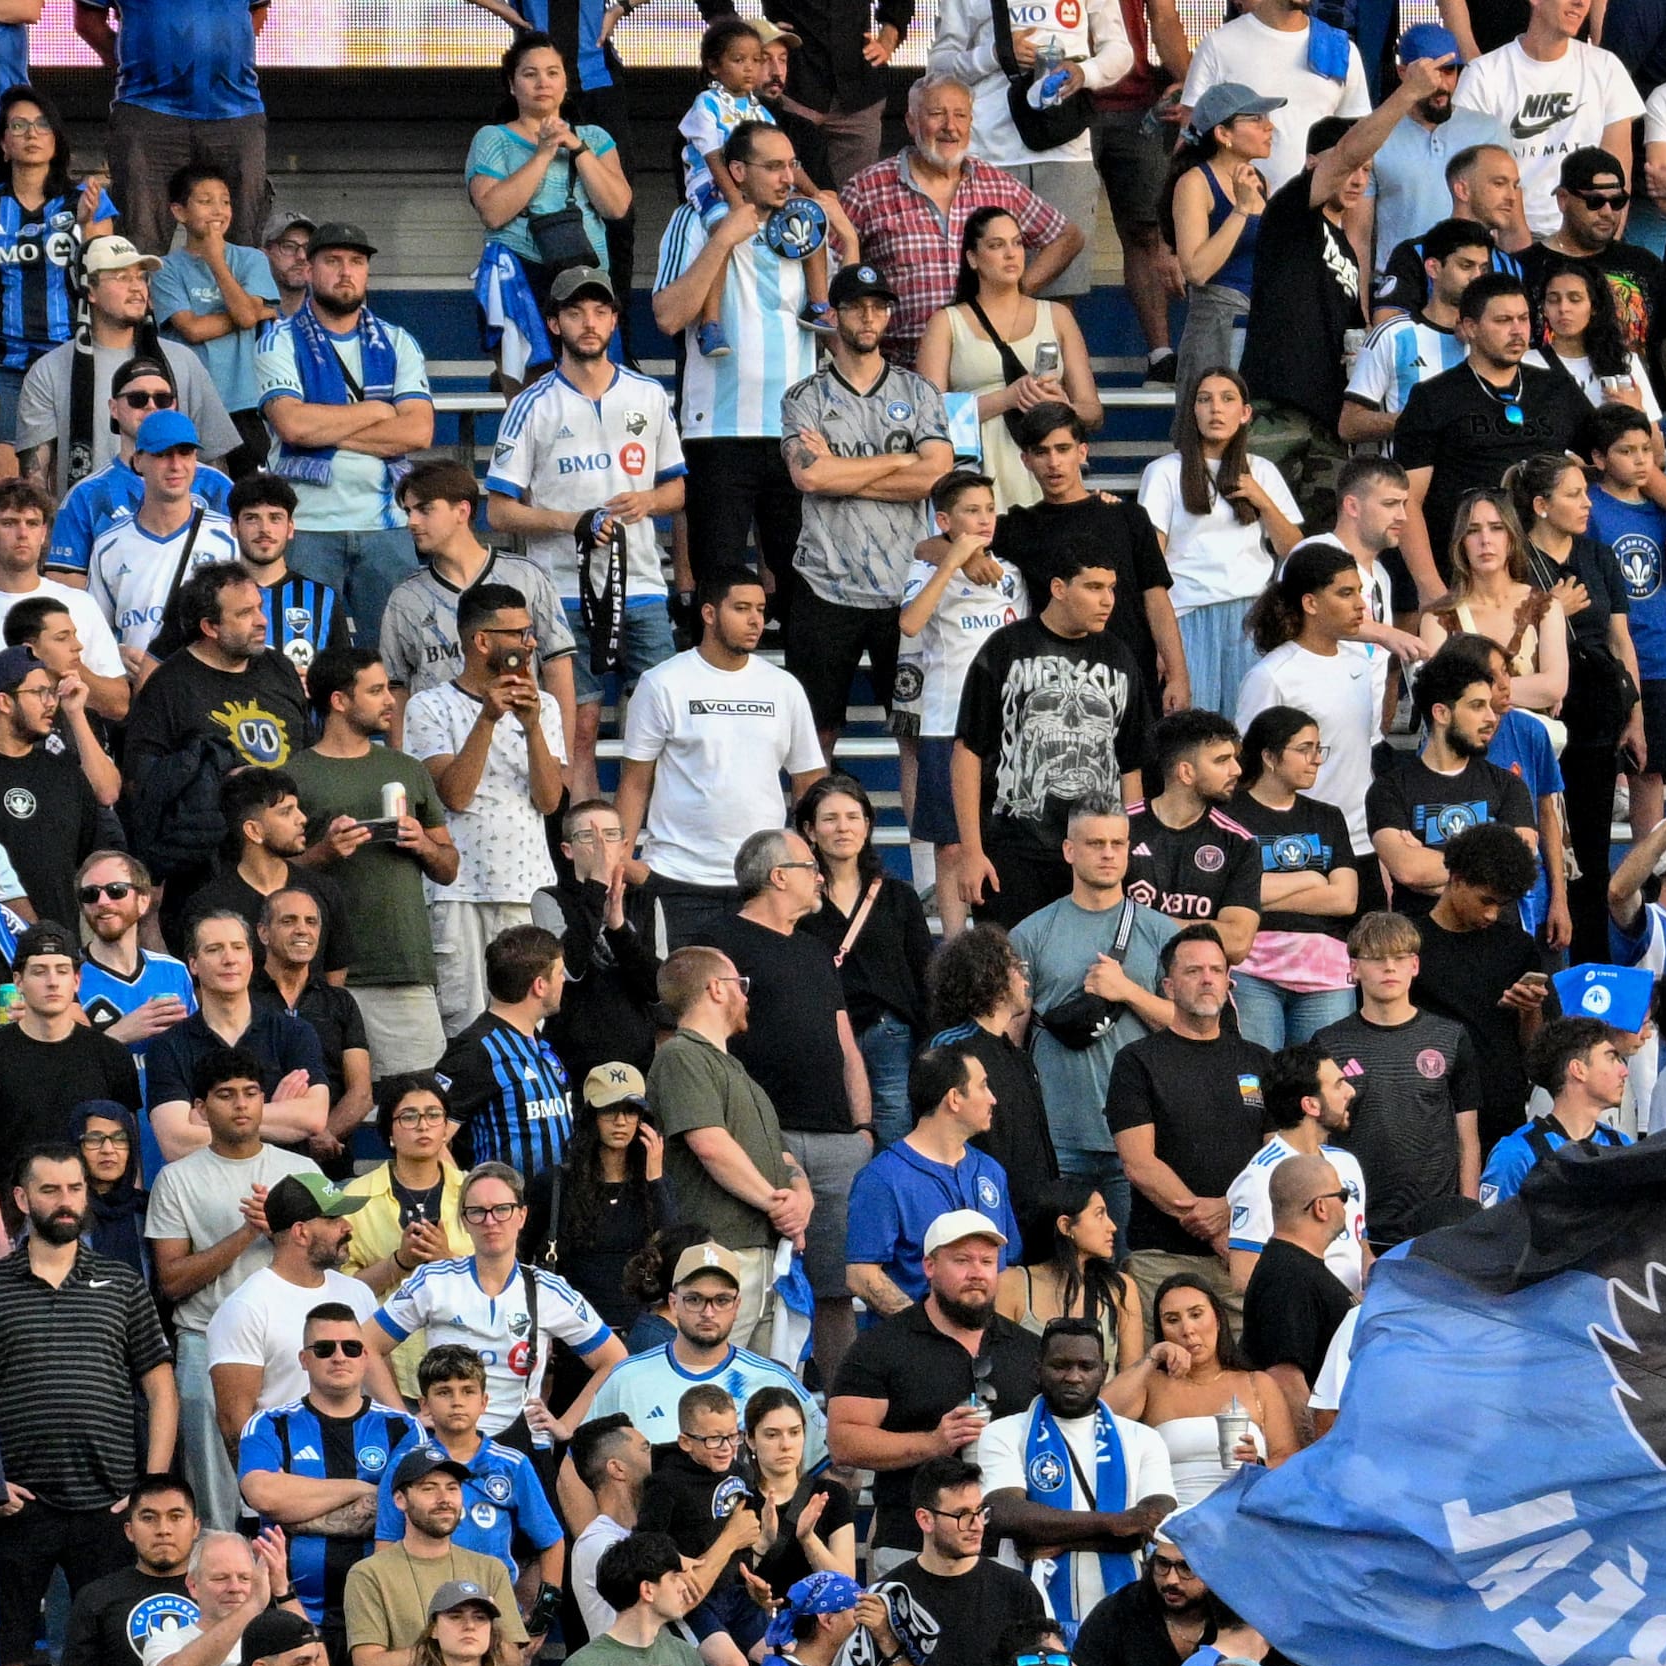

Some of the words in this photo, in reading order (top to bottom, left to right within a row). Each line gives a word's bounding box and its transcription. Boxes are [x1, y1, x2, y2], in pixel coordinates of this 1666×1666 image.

[1010, 5, 1047, 23] MO
[1520, 92, 1574, 119] NIKE
[556, 453, 612, 475] BMO
[961, 615, 1001, 630] BMO
[426, 644, 461, 664] BM
[705, 702, 773, 714] VOLCOM
[525, 1098, 566, 1120] BMO
